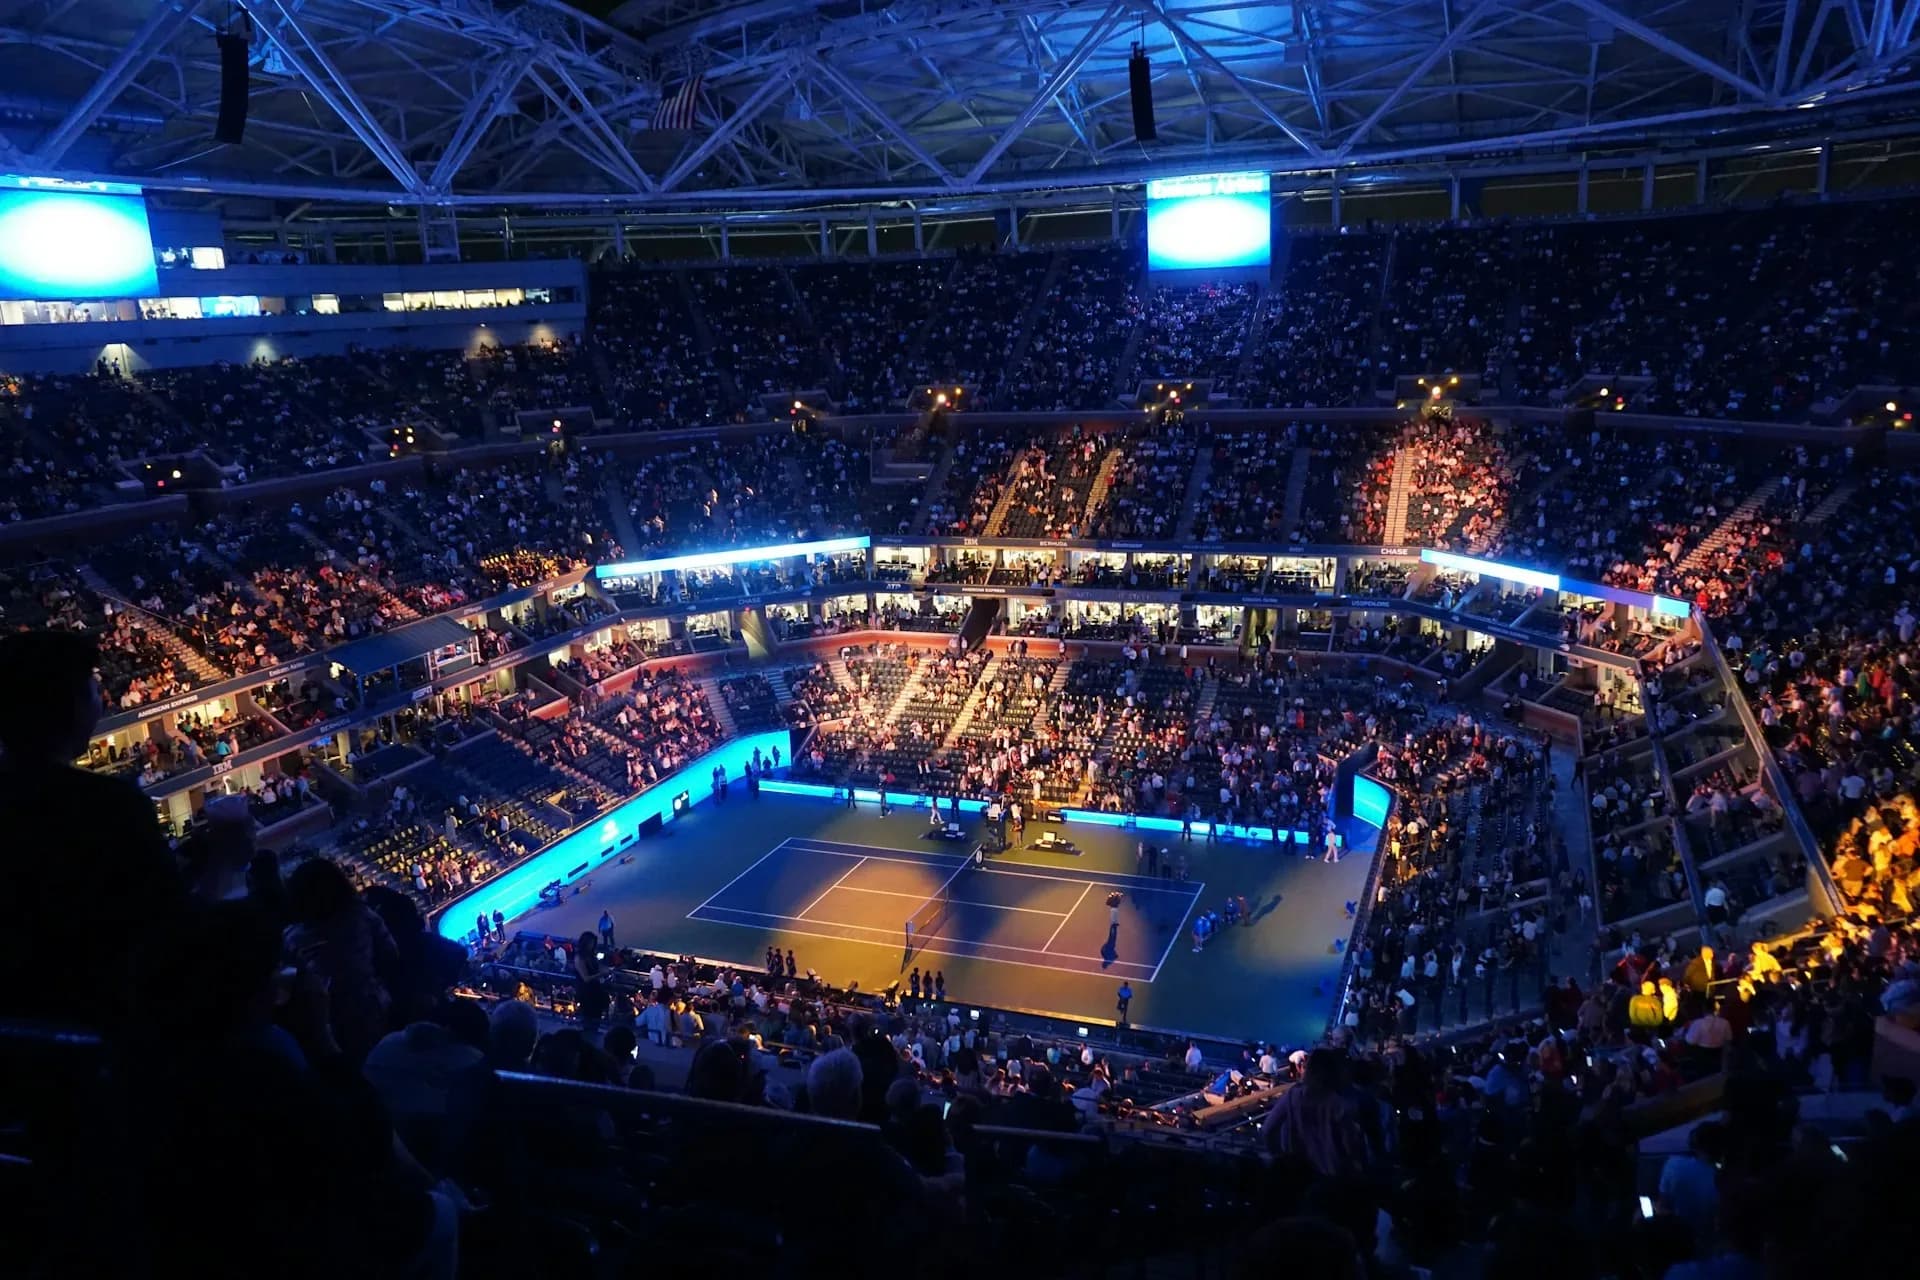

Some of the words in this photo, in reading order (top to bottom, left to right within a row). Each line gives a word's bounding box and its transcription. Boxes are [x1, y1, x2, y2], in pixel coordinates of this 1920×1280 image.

[537, 581, 555, 592] CHASE
[738, 597, 761, 605] CHASE
[137, 704, 170, 718] AMERICAN
[170, 694, 198, 708] EXPRESS
[212, 759, 233, 775] IBM
